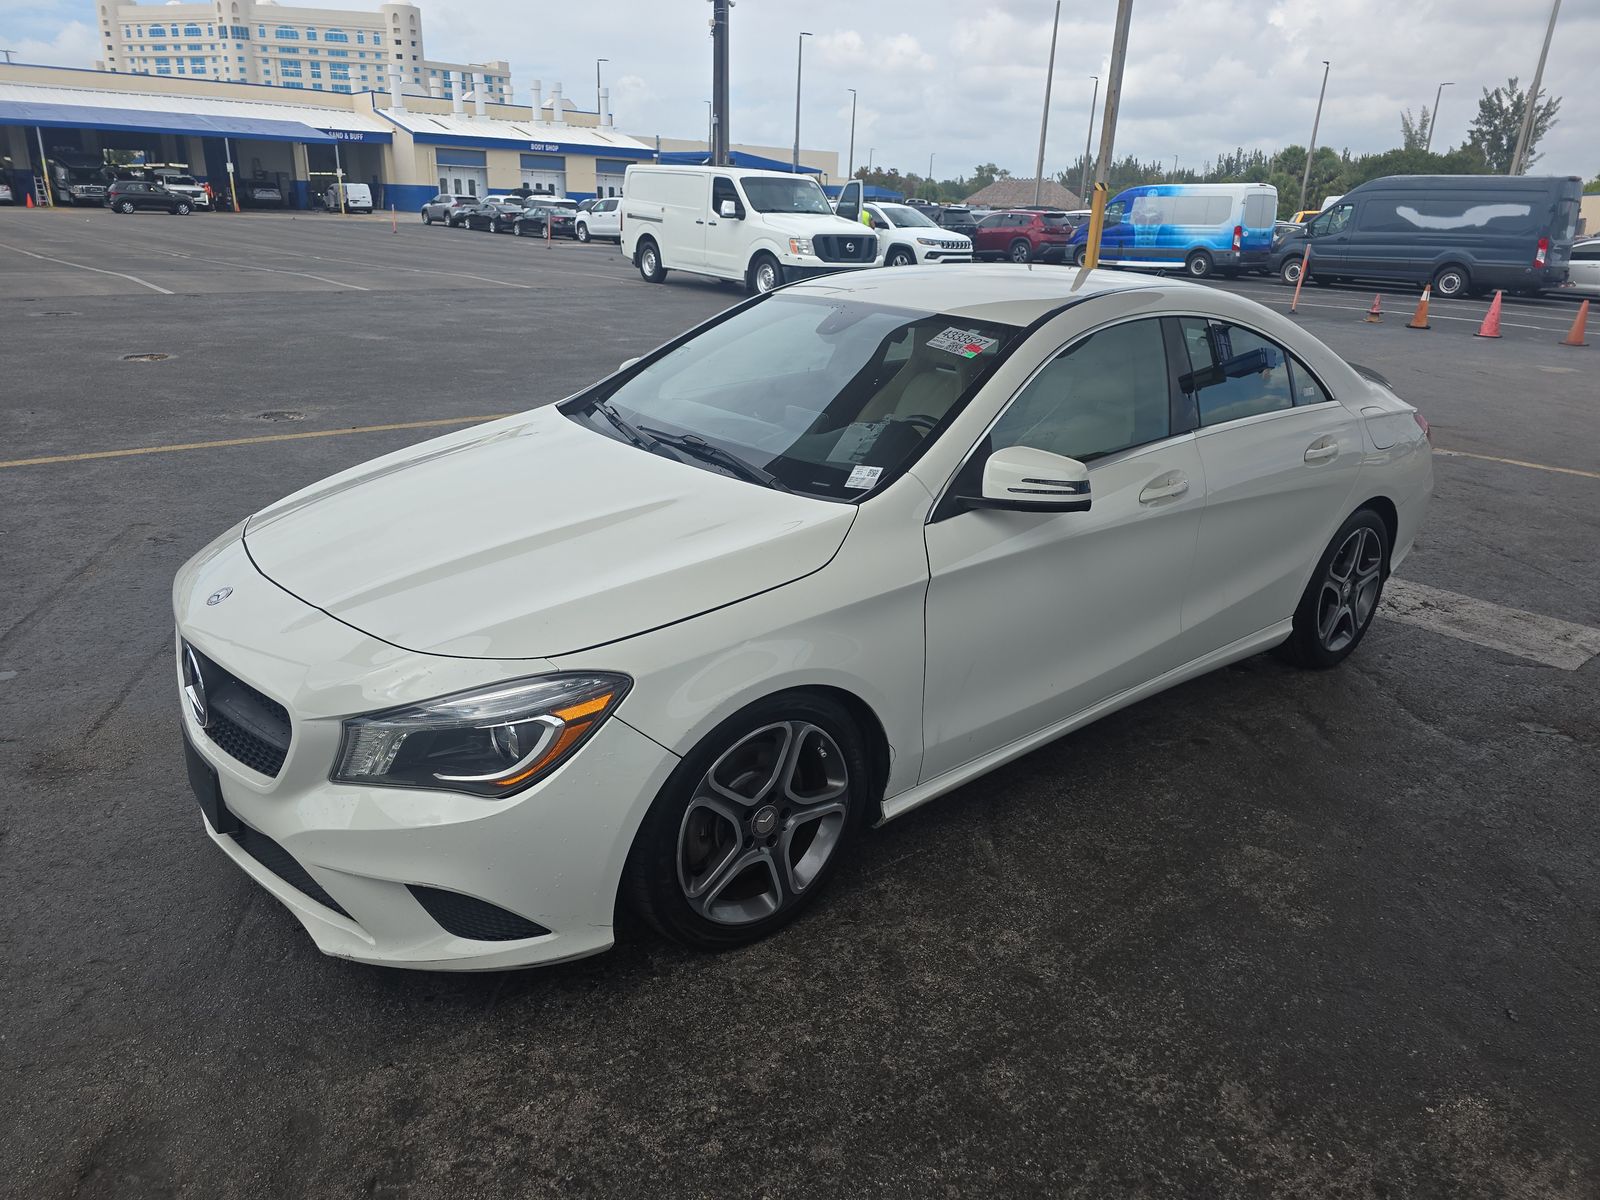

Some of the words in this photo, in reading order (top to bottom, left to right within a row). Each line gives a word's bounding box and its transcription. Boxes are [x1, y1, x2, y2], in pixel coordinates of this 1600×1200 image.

[328, 131, 344, 139] SAND
[344, 132, 349, 140] &
[350, 133, 364, 141] BUFF
[530, 143, 544, 151] BODY
[545, 144, 559, 152] SHOP
[943, 330, 989, 346] 4333527
